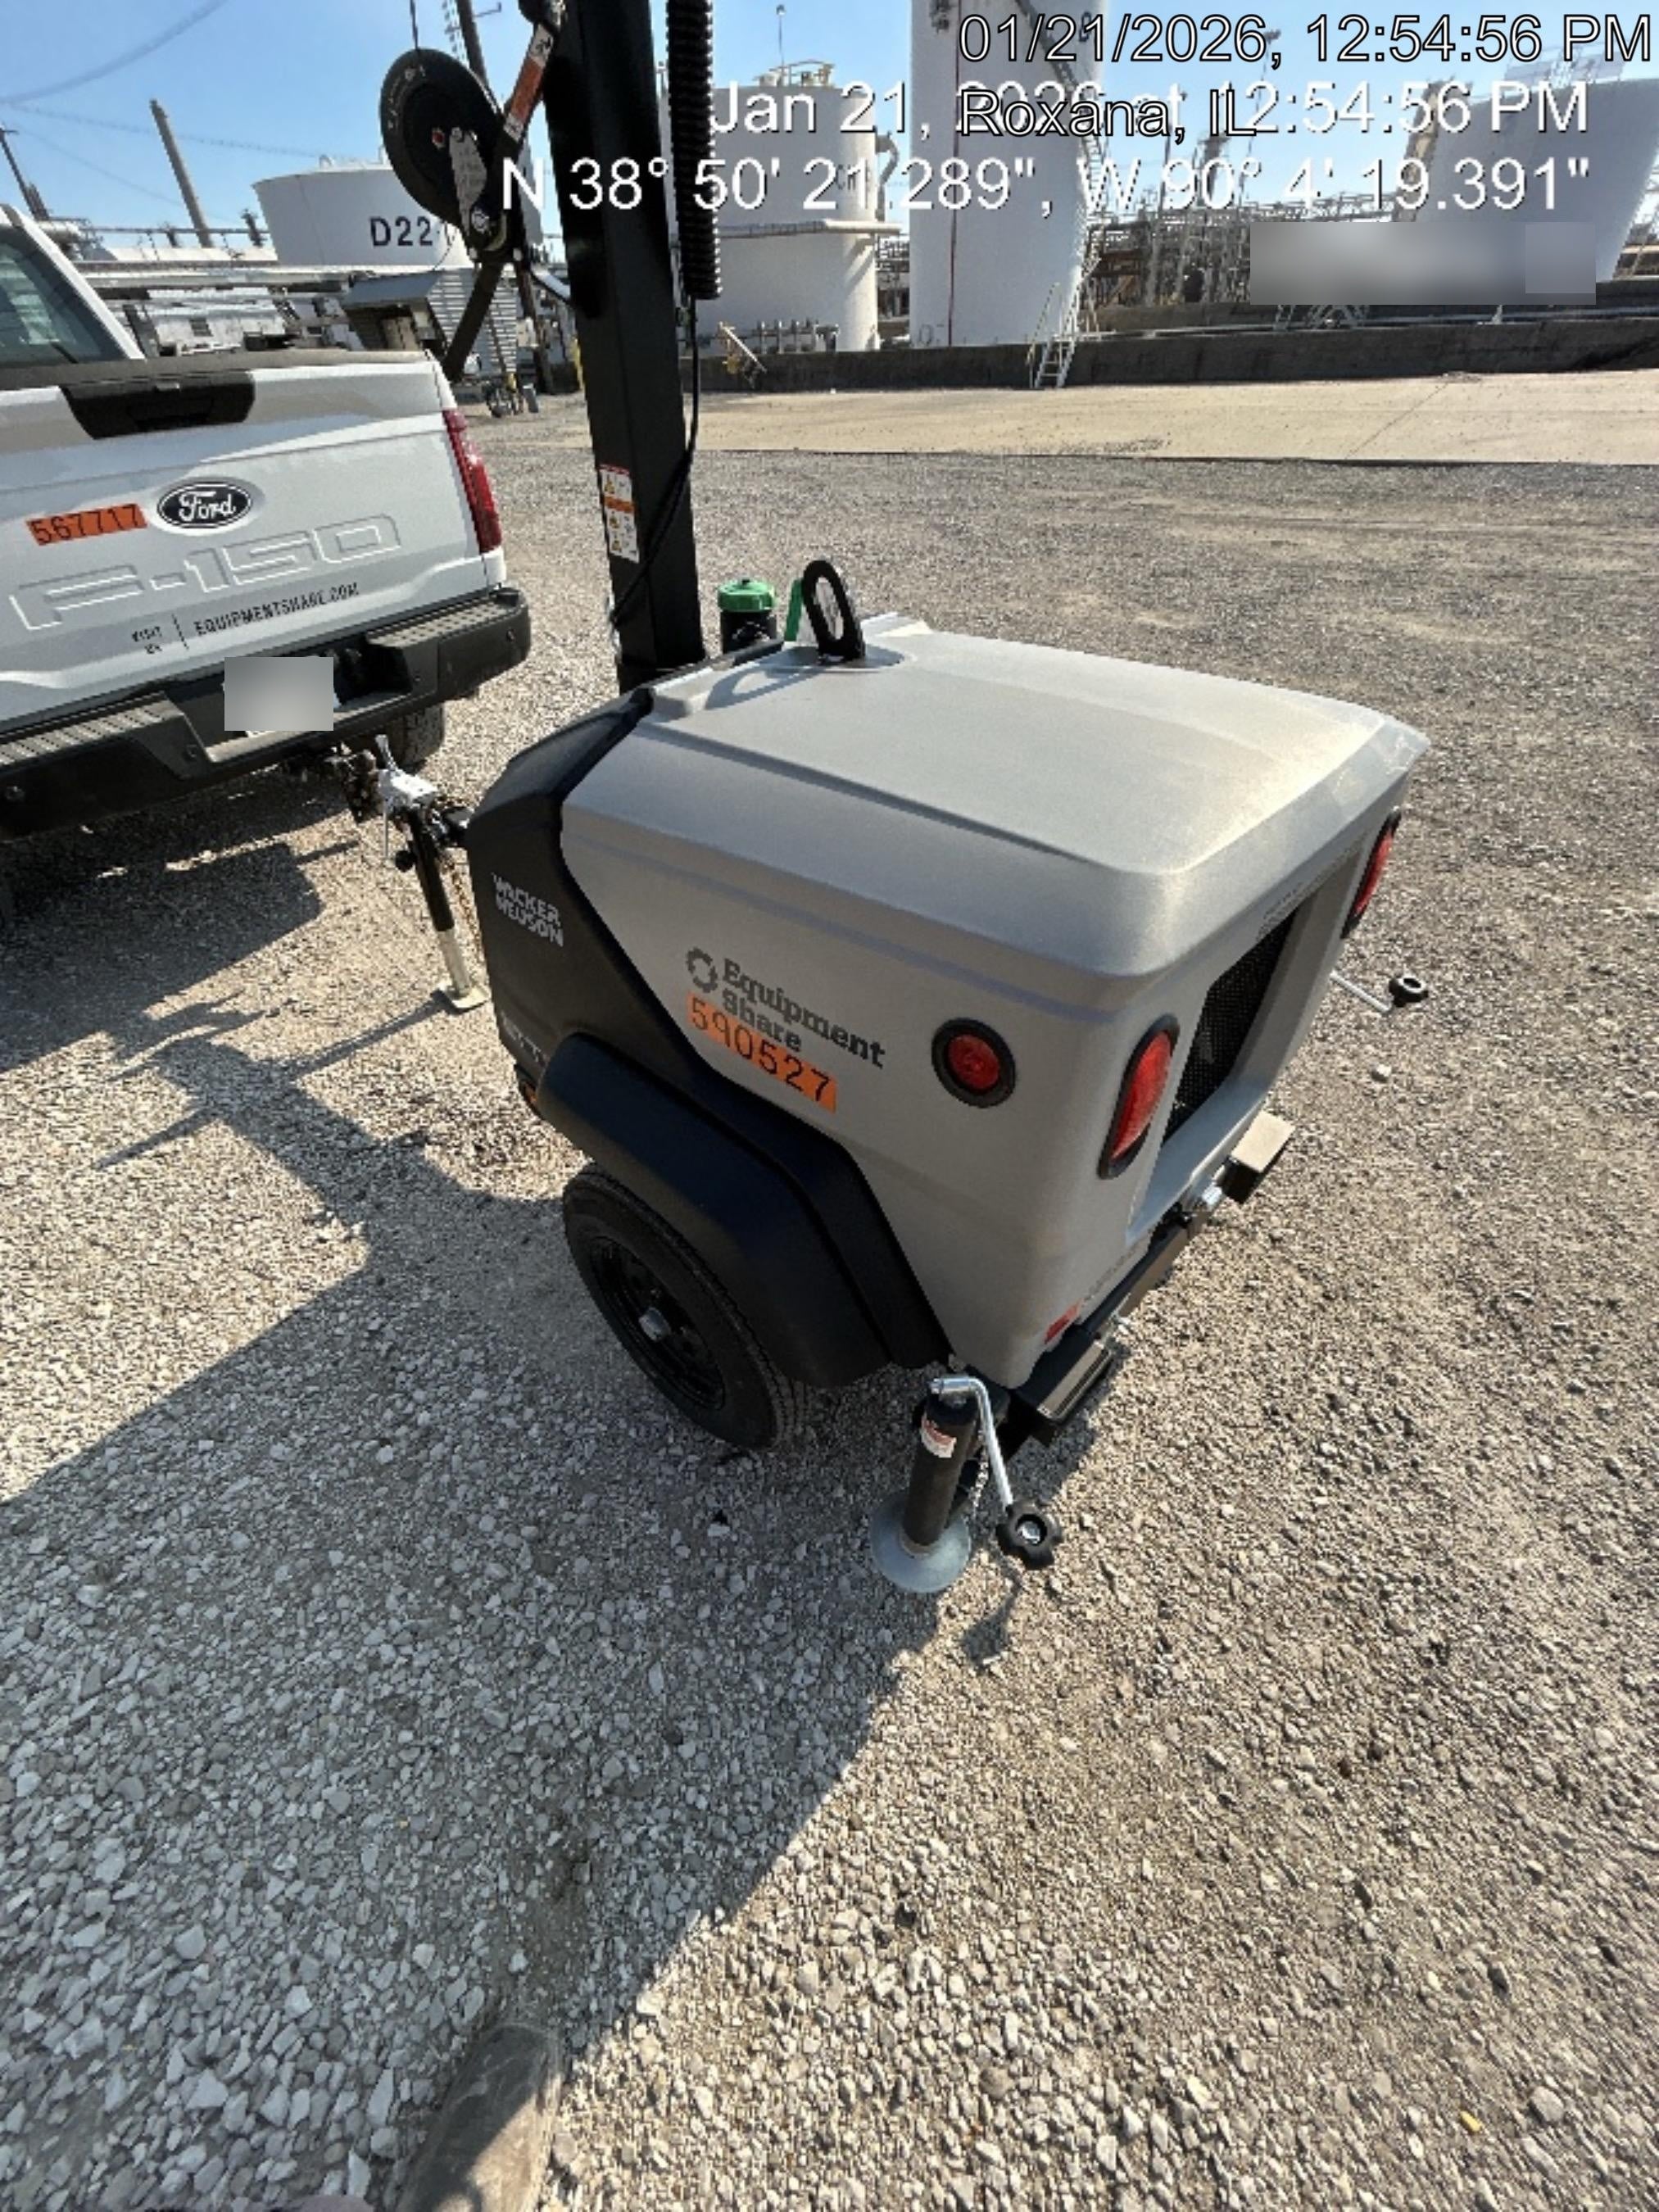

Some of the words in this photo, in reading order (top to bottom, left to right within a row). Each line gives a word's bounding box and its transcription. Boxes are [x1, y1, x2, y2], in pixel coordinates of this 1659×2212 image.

[29, 503, 143, 546] 567717
[178, 490, 238, 523] Ford
[8, 514, 402, 631] F-150
[193, 582, 359, 637] EQUIPMENTSHARE.COM
[491, 872, 561, 927] WACKER
[496, 893, 564, 947] NEUSON
[723, 958, 886, 1069] Equipment
[723, 987, 802, 1052] Share
[691, 996, 830, 1102] 590527
